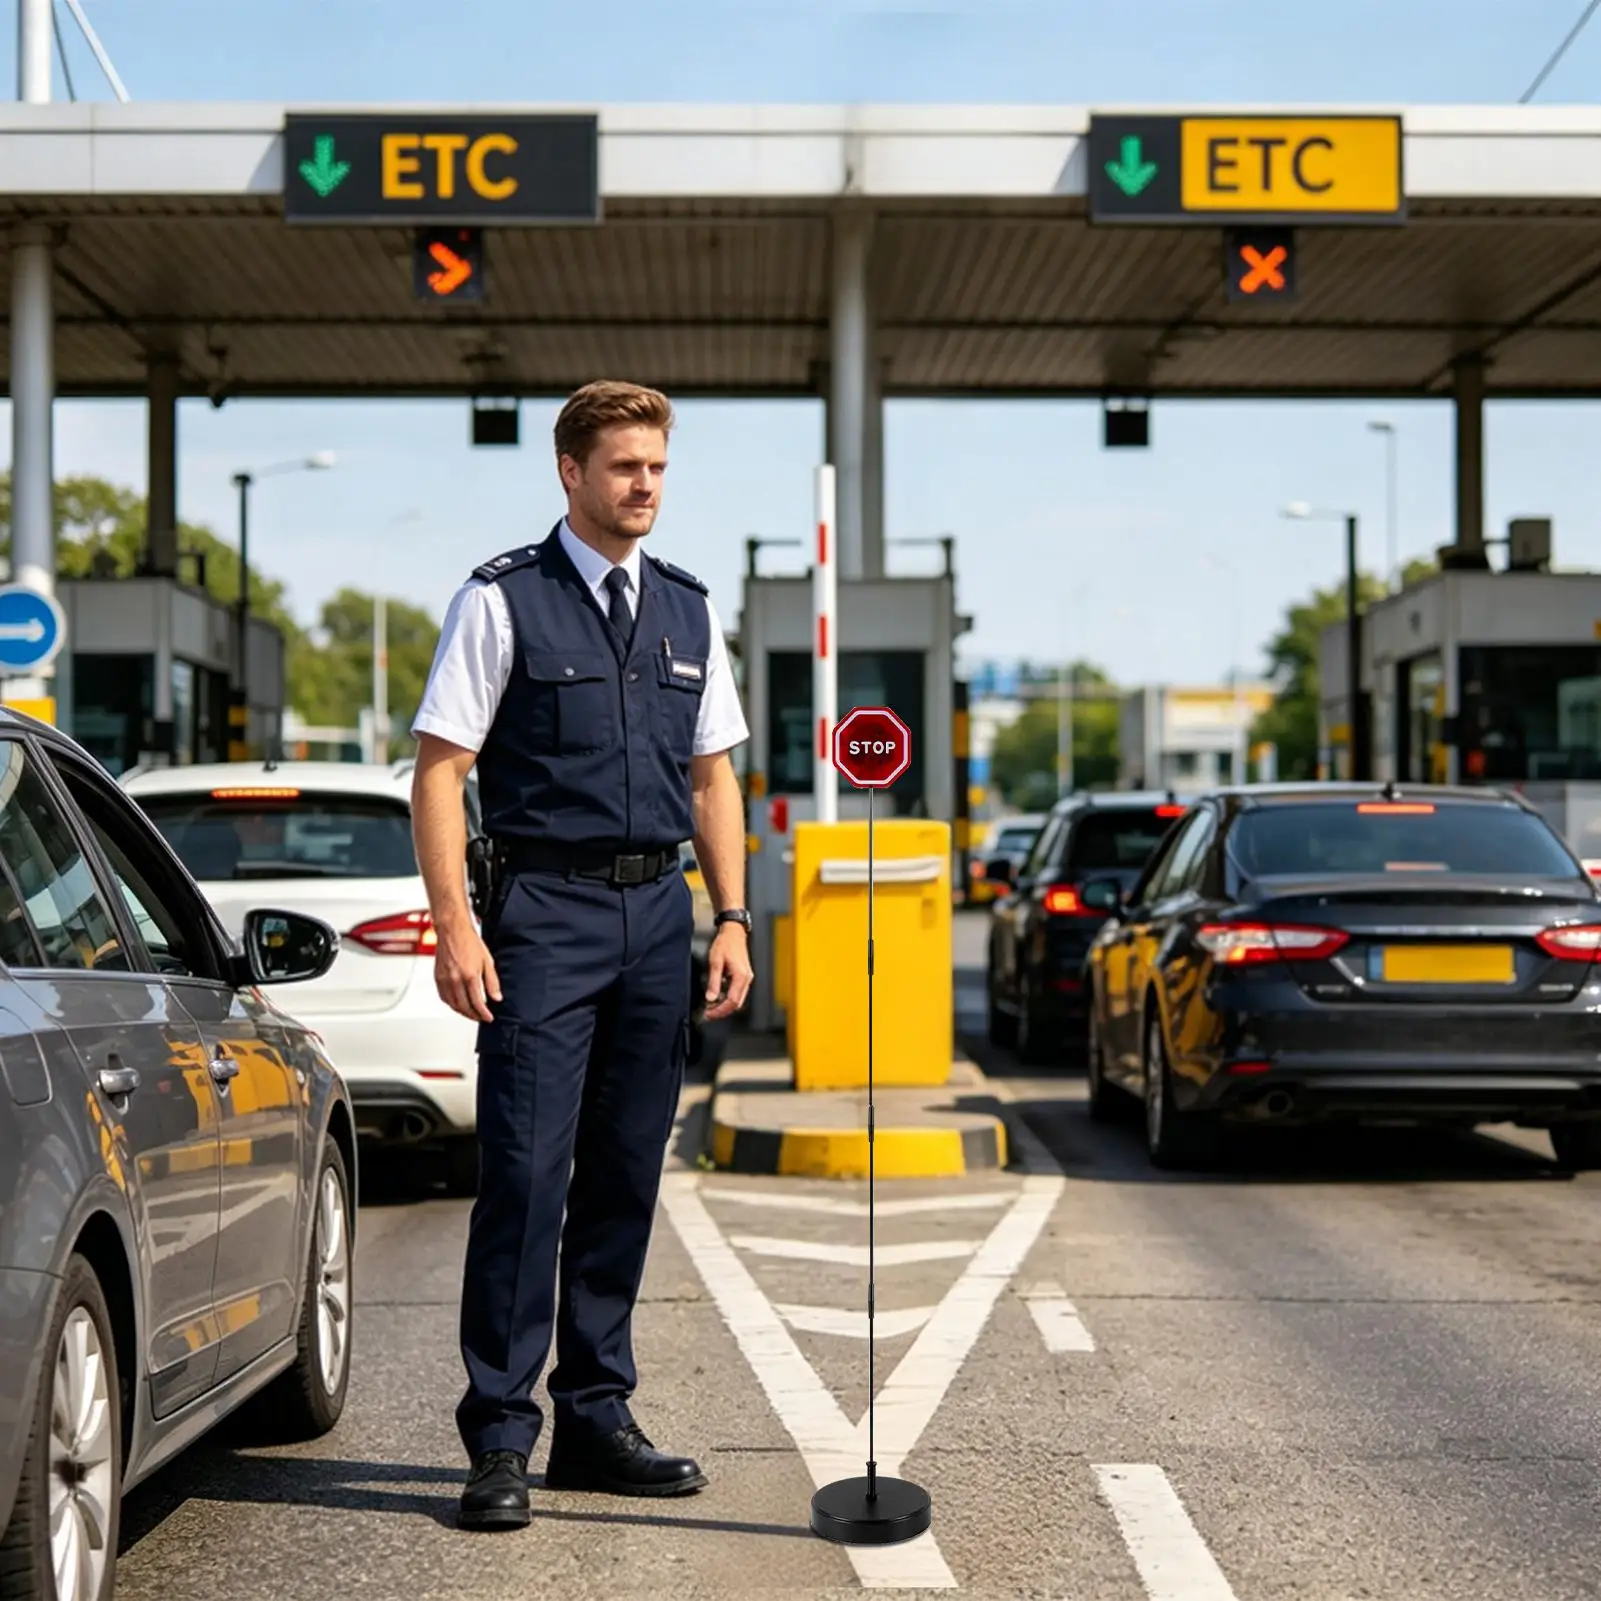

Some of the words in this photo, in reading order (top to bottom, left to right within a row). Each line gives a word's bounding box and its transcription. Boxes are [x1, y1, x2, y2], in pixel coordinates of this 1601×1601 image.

[382, 133, 518, 200] ETC
[1207, 136, 1334, 194] ETC
[849, 740, 896, 755] STOP
